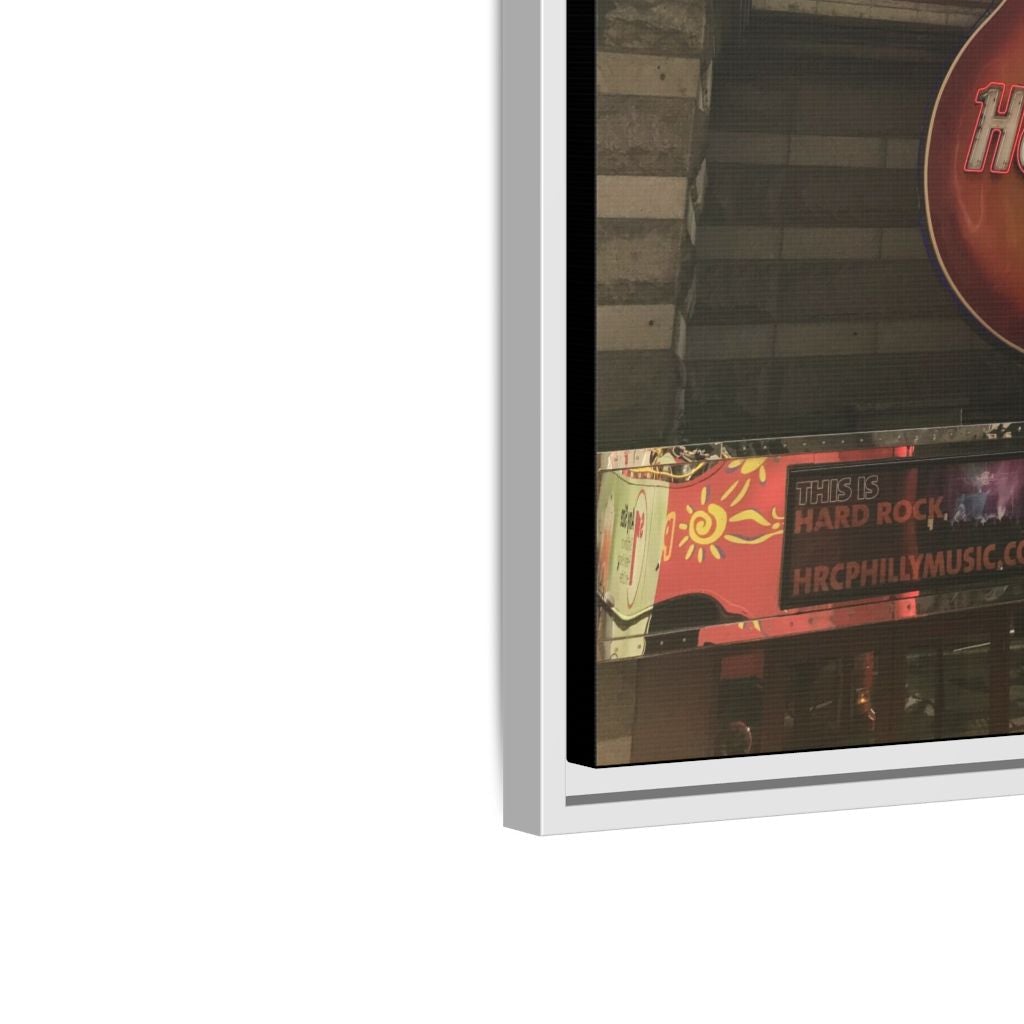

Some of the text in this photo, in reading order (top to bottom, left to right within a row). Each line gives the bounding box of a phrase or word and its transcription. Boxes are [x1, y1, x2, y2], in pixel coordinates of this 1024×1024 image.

[796, 475, 880, 505] THIS IS
[794, 504, 870, 534] HARD
